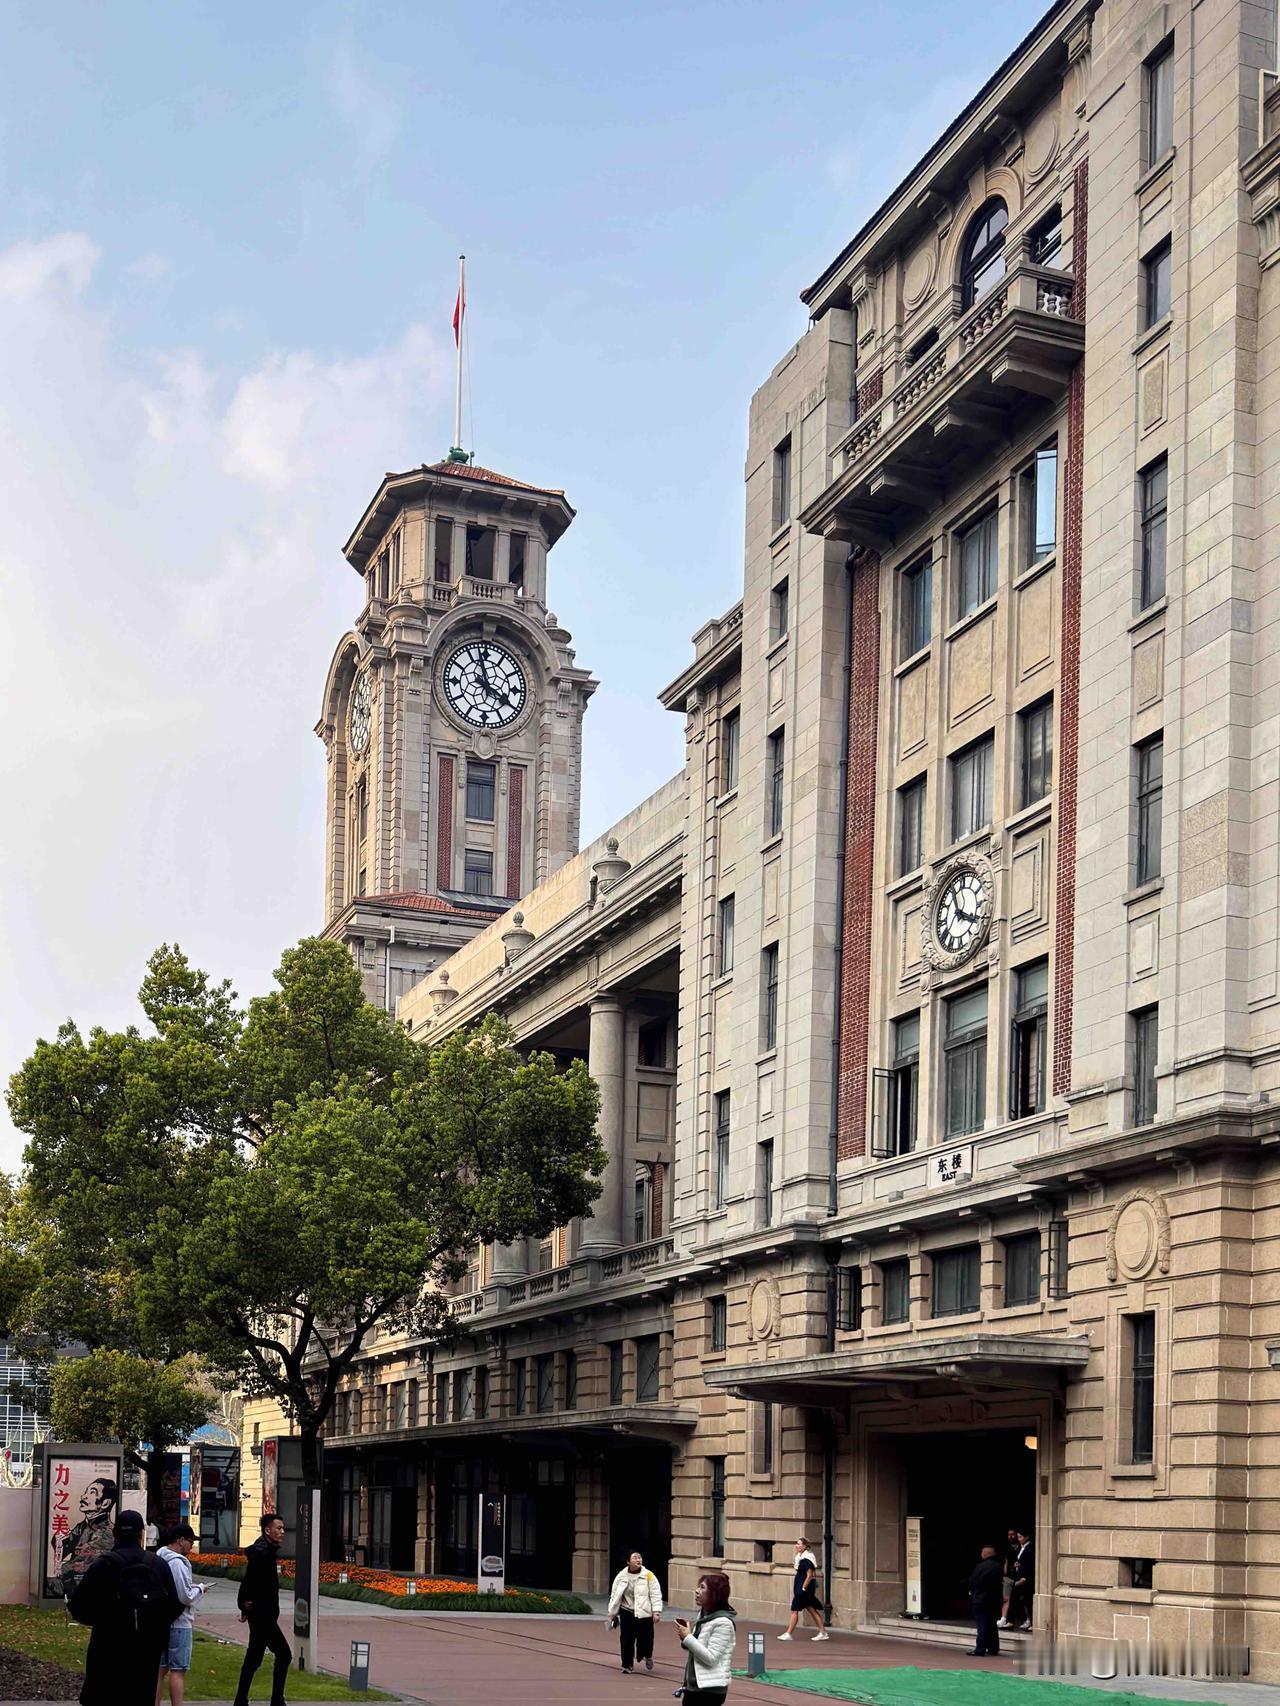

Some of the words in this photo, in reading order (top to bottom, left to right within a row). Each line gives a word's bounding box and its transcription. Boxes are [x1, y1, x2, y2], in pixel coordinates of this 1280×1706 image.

[937, 1153, 962, 1173] 东楼
[942, 1170, 957, 1182] EAST
[52, 1464, 70, 1536] 力之美
